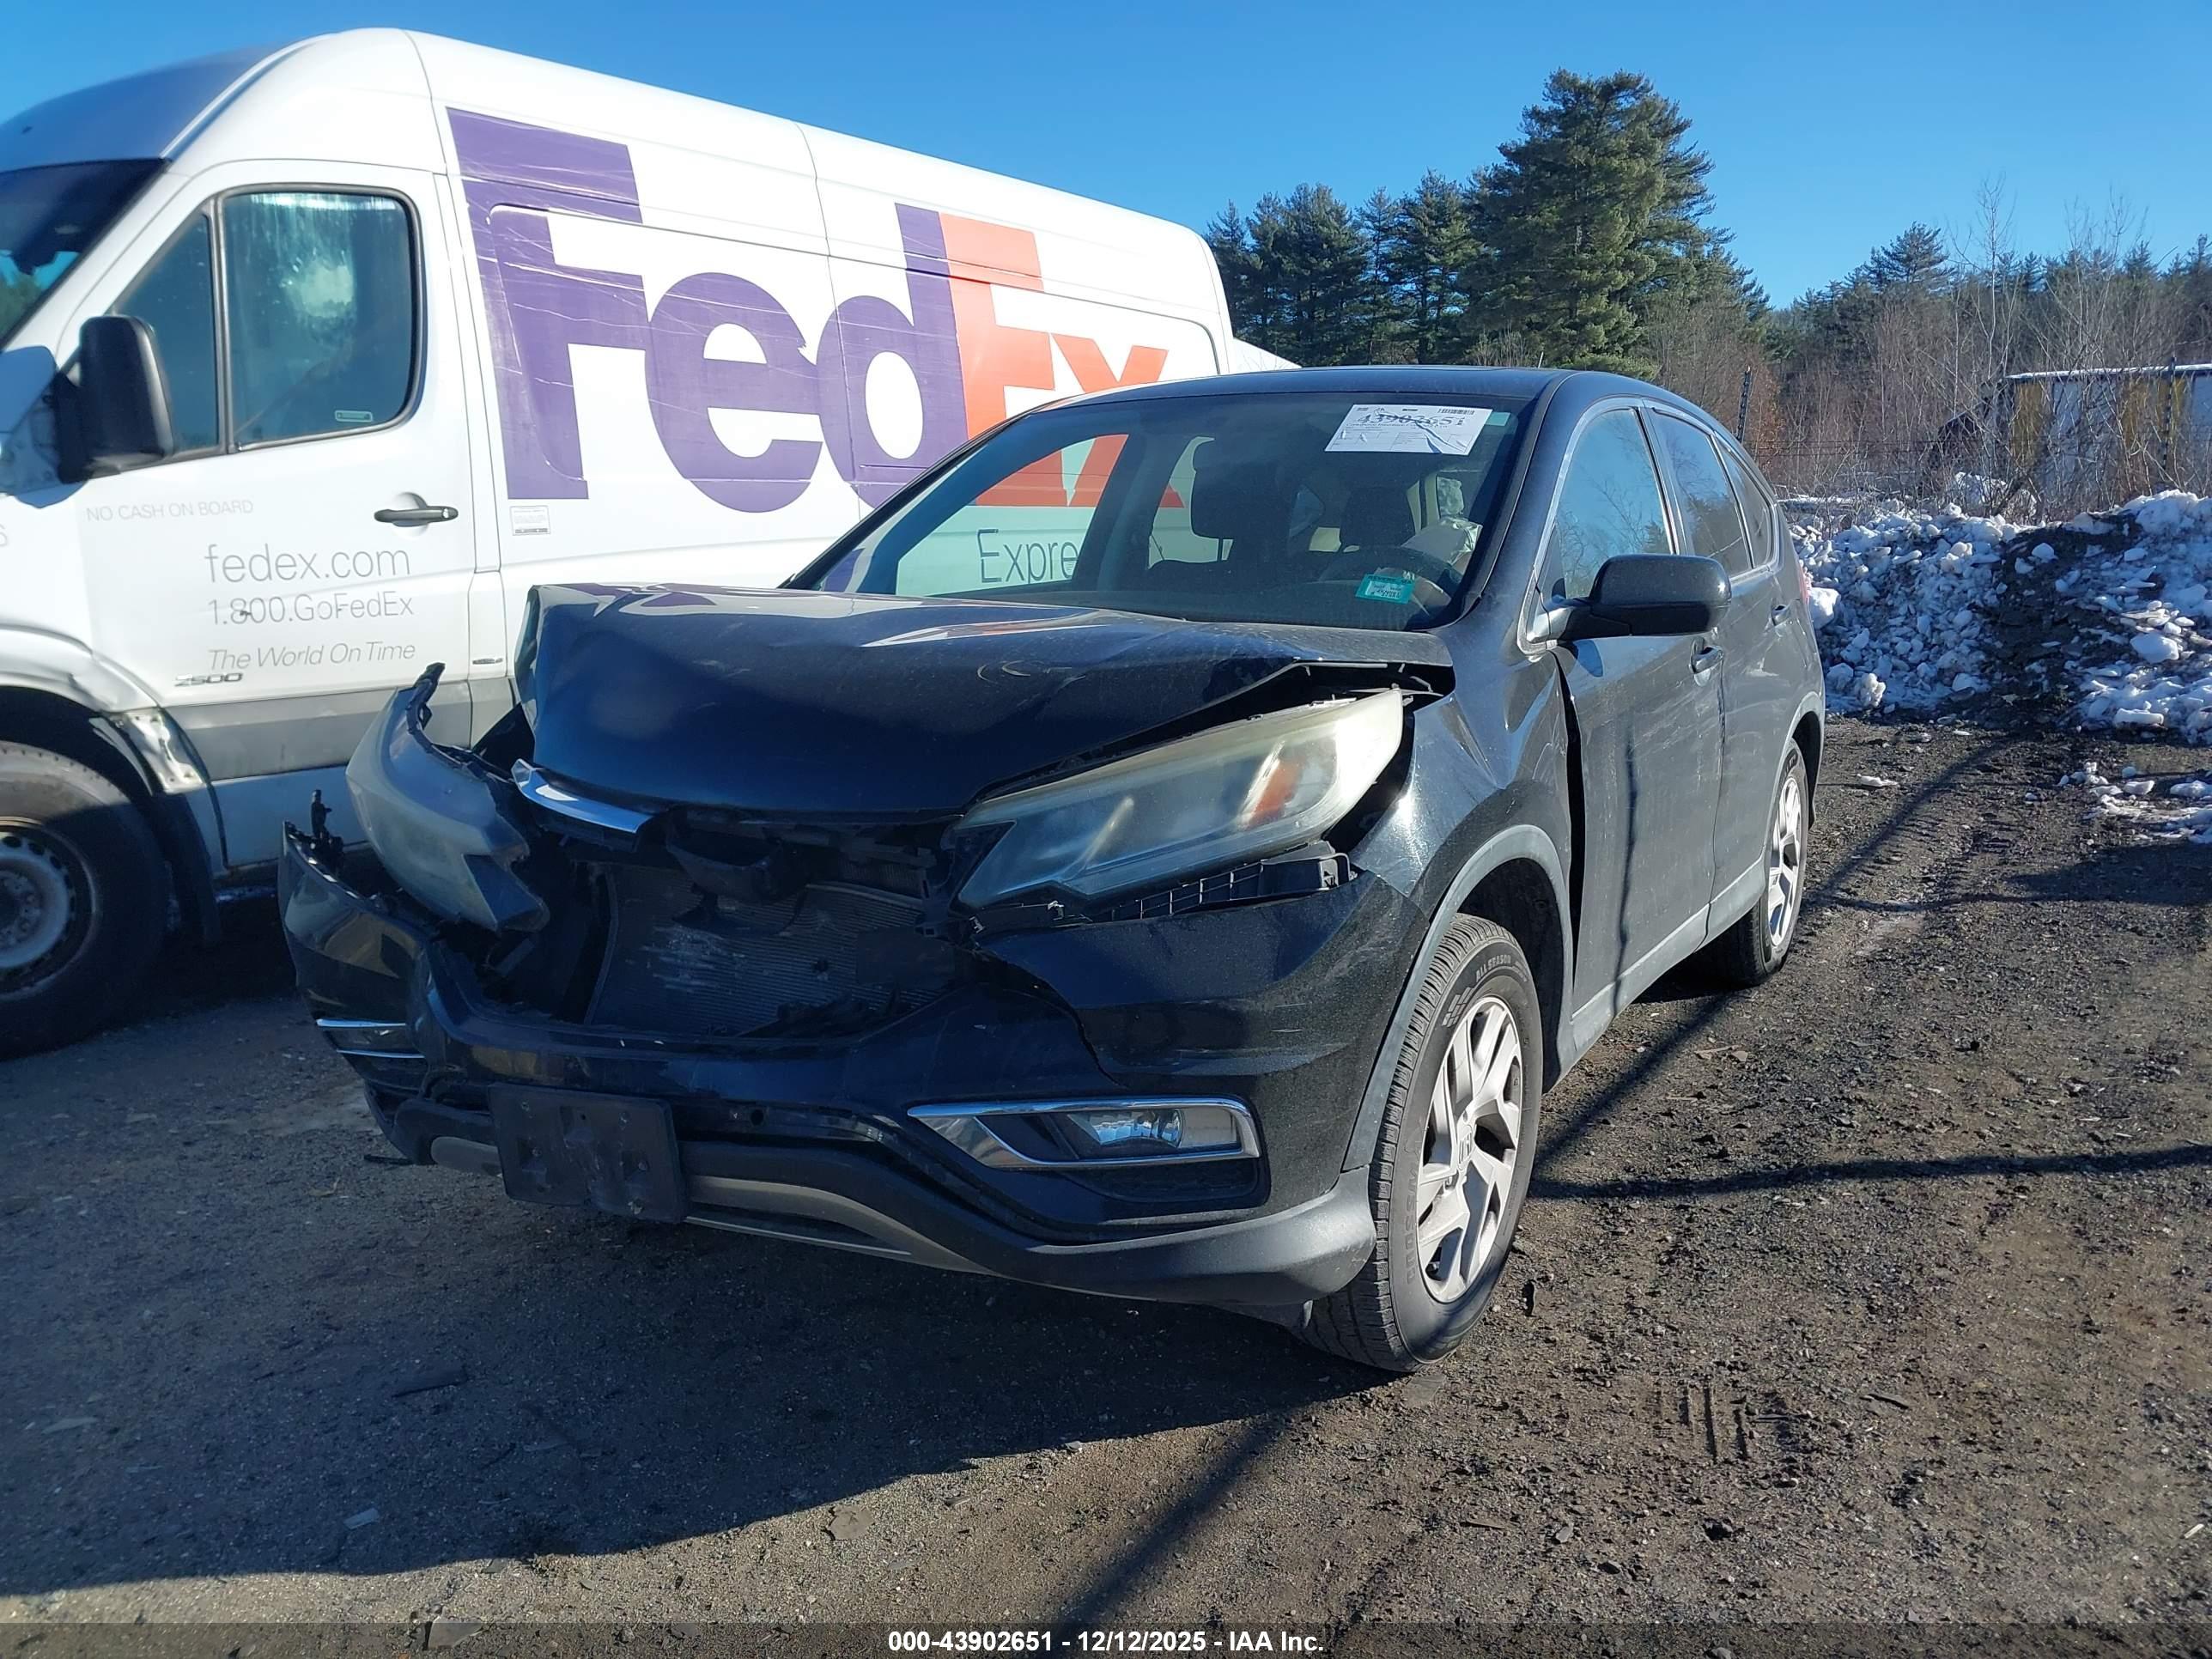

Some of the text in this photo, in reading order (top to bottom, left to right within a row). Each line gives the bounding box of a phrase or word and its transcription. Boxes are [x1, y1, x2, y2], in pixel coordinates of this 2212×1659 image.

[446, 107, 1184, 513] FedEx
[87, 500, 253, 521] NO CASH ON BOARD
[204, 543, 410, 583] fedex.com
[977, 528, 1079, 584] Expre
[209, 591, 415, 624] 1.800.GoFedEx
[210, 641, 416, 671] The World On Time
